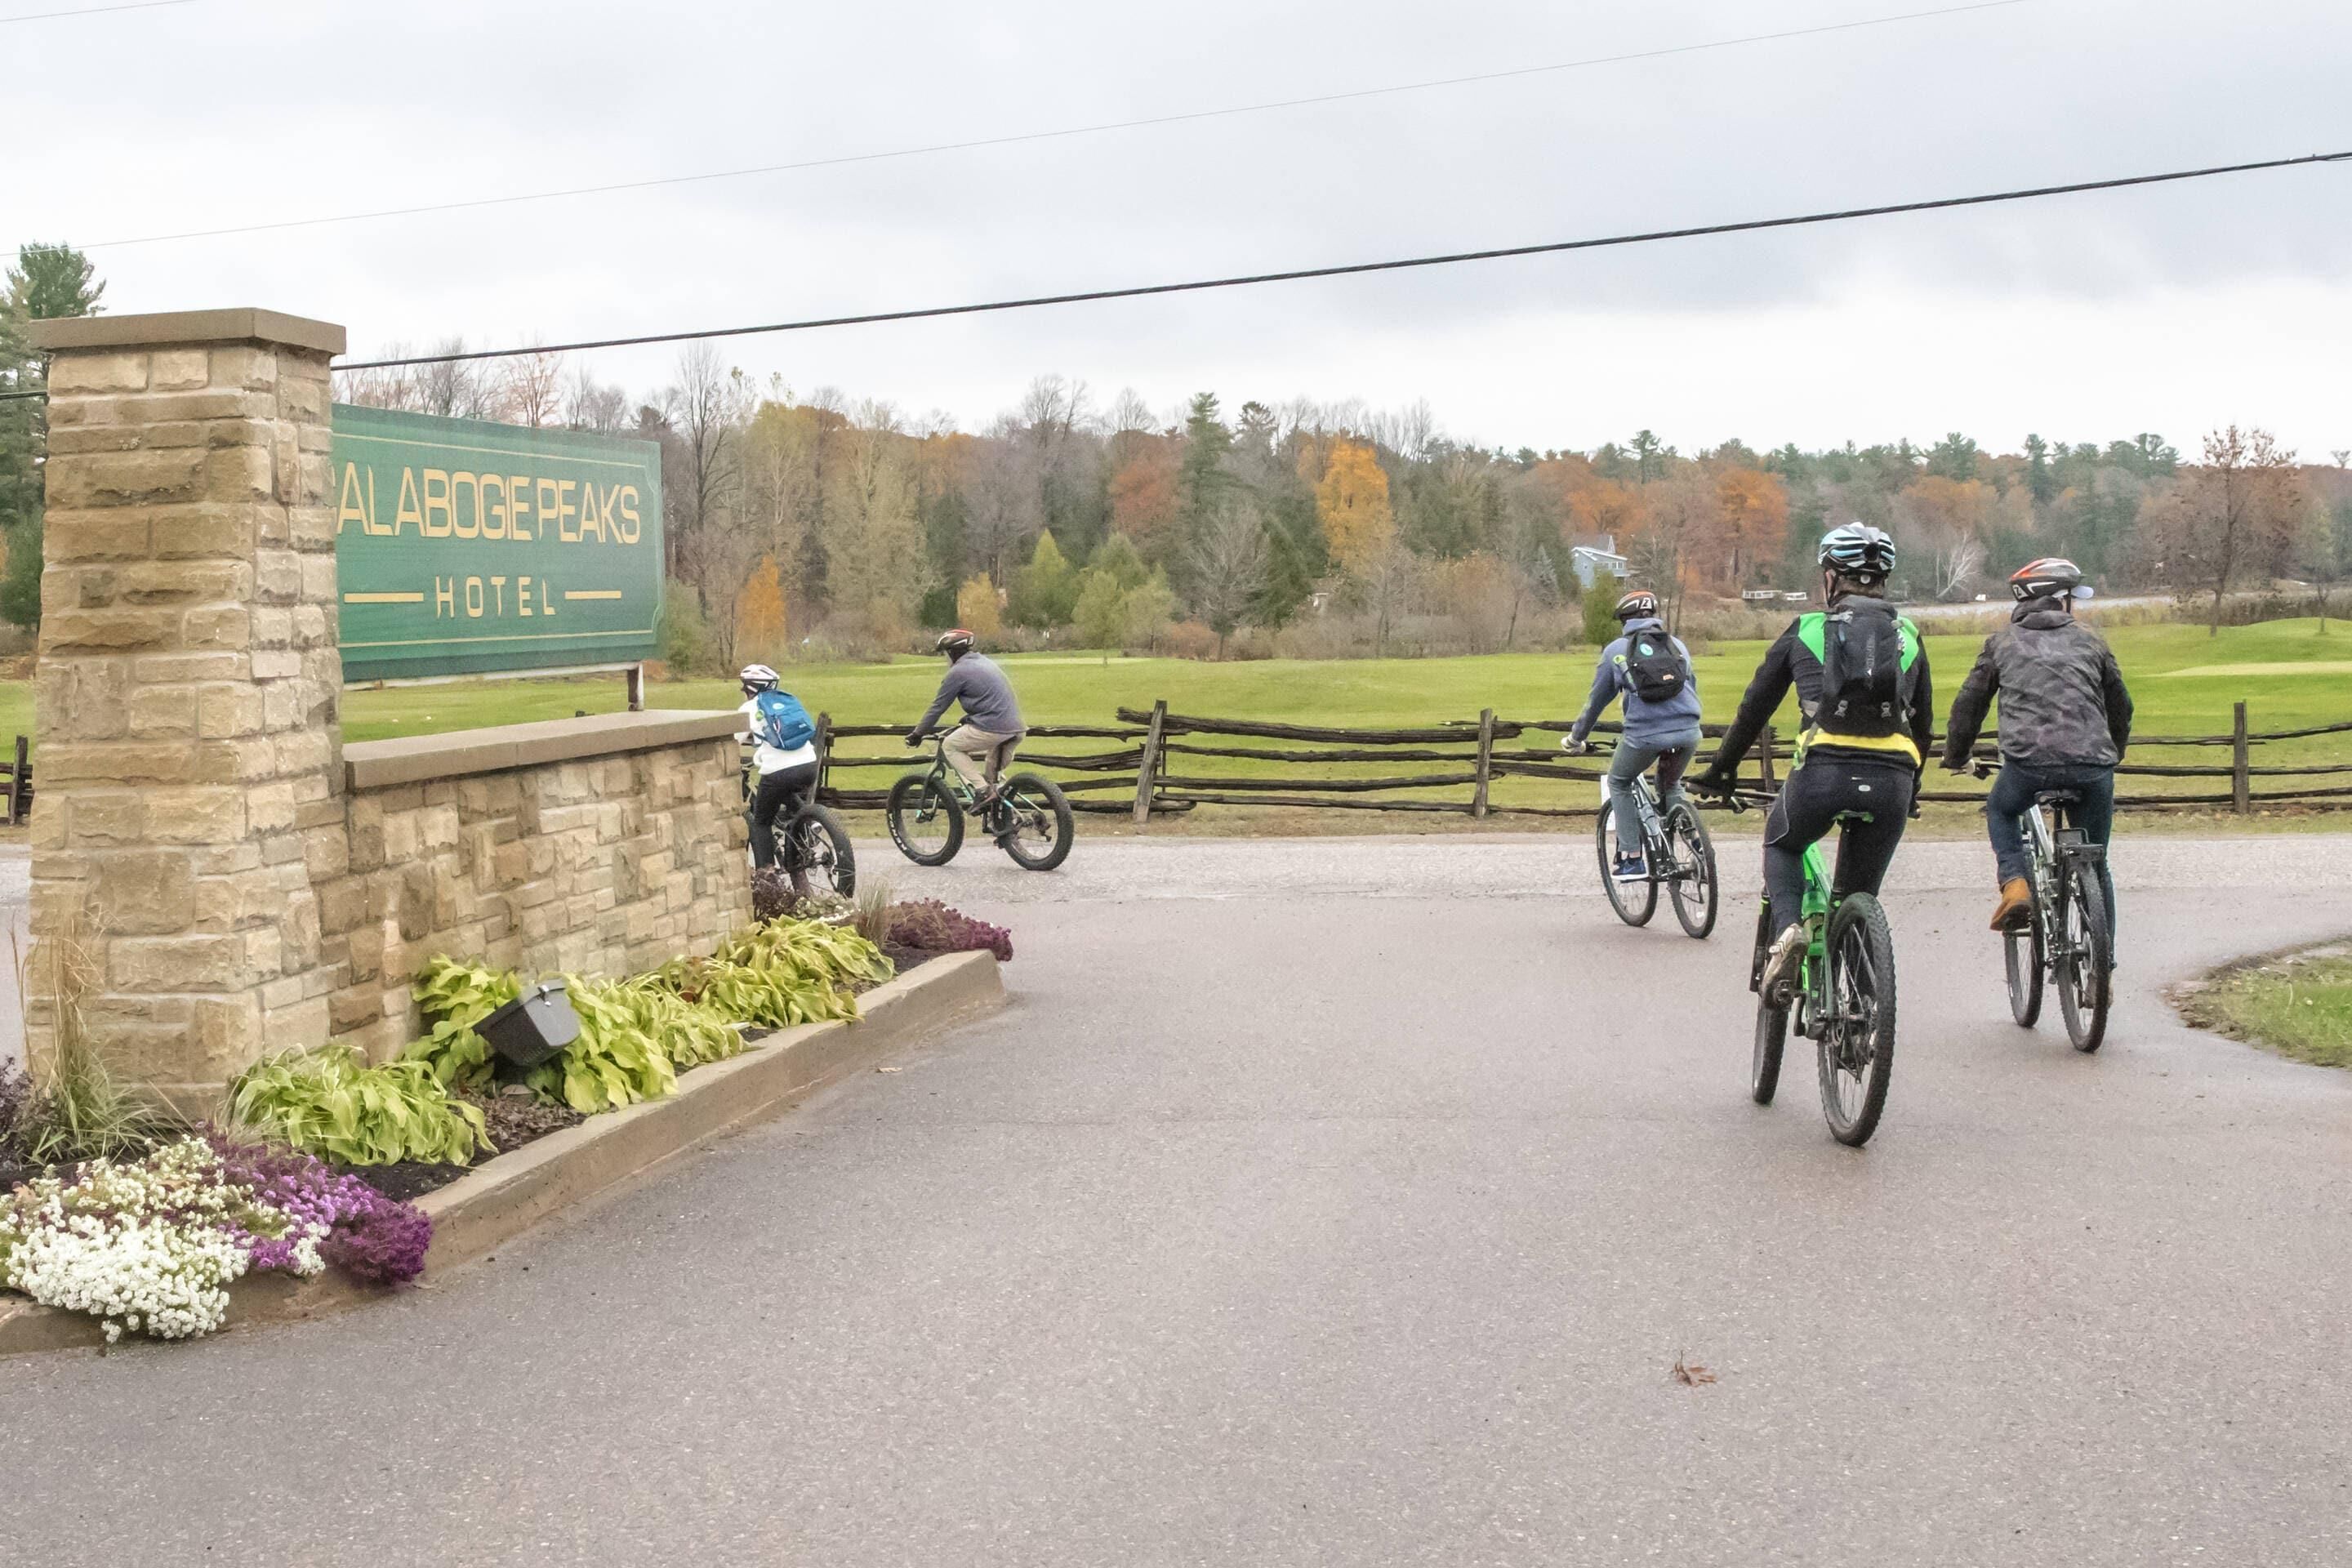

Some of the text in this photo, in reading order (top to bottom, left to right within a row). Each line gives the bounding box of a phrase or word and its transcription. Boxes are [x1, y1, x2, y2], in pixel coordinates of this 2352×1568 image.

[332, 461, 641, 544] ALABOGIE PEAKS
[435, 575, 556, 618] HOTEL
